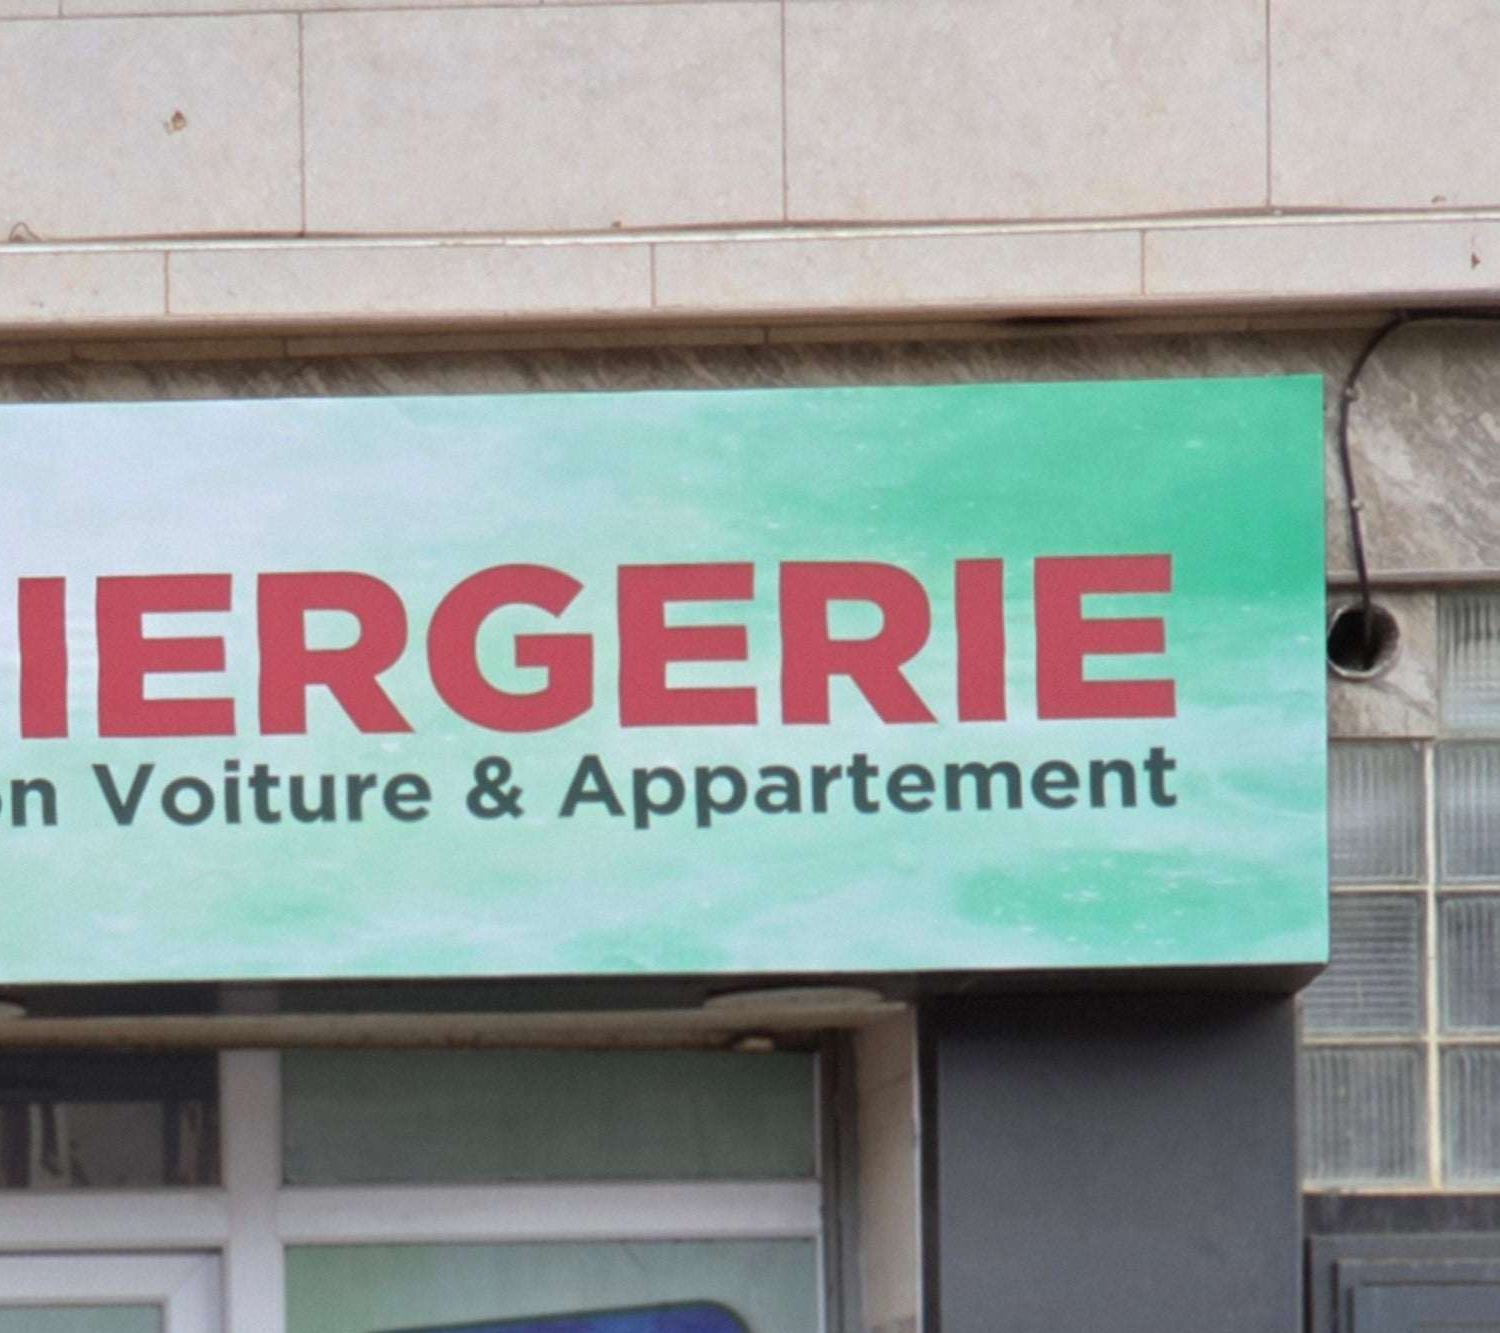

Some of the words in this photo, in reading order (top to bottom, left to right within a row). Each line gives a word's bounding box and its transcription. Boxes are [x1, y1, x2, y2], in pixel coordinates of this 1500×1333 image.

[93, 758, 431, 826] Voiture
[465, 756, 524, 818] &
[558, 746, 1178, 829] Appartement
